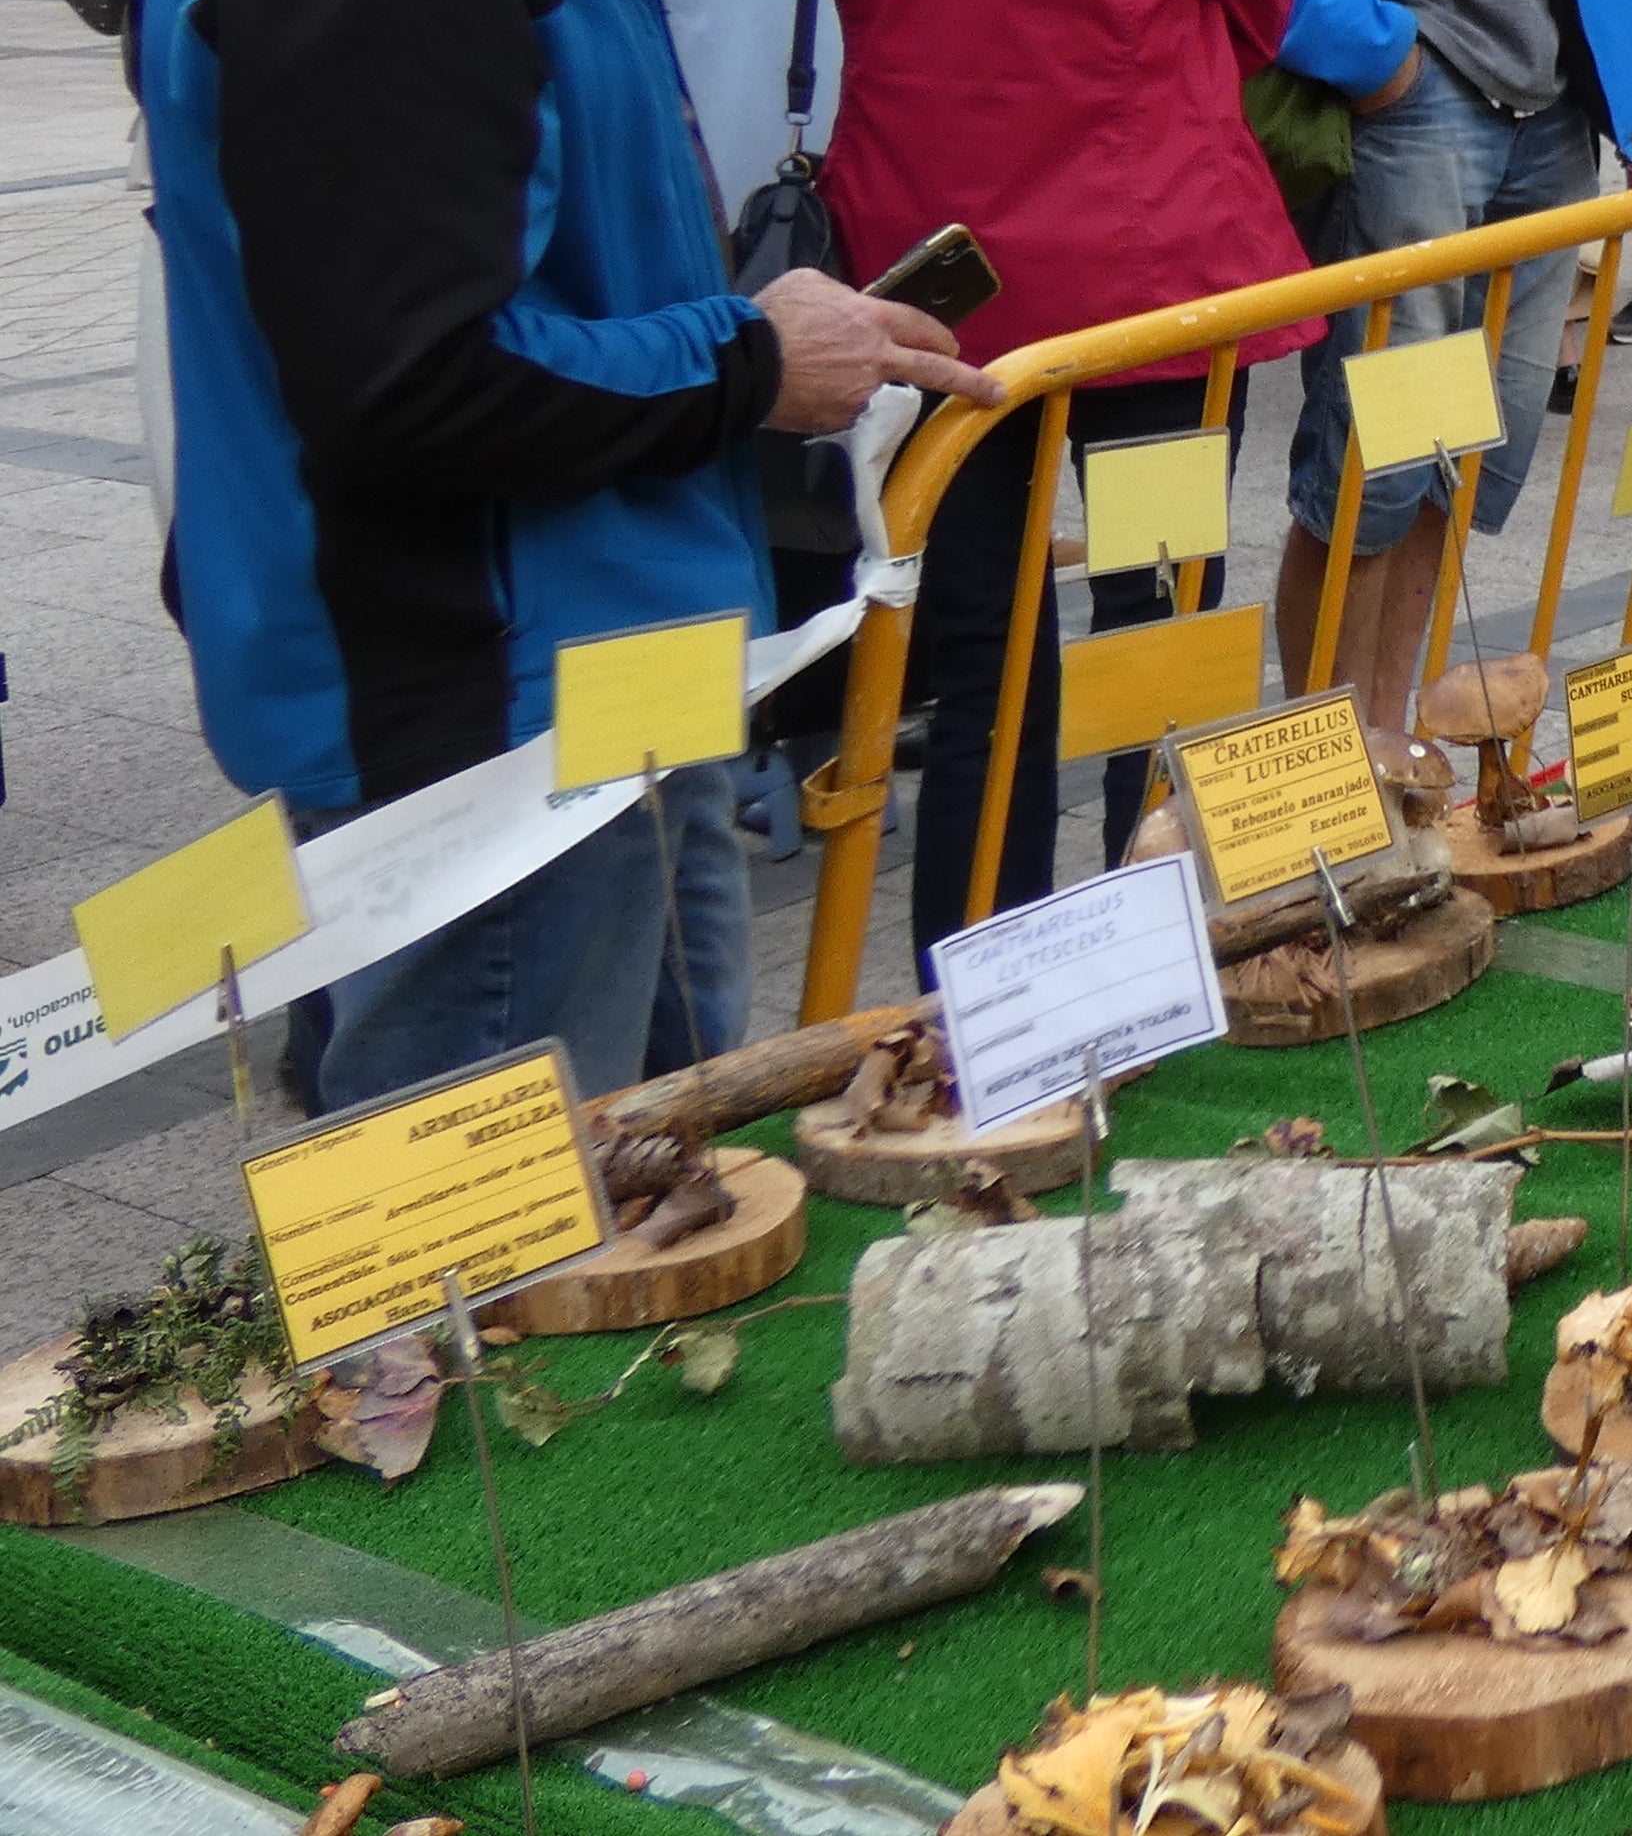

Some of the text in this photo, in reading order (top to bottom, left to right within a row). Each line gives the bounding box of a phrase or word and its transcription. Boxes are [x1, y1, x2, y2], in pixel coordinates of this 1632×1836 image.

[1214, 709, 1349, 765] CRATERELLUS
[1246, 734, 1354, 784] LUTESCENS
[1231, 775, 1371, 832] Rebozuelo anaranjado
[1309, 805, 1368, 834] Excelente
[1291, 846, 1344, 875] DEPTIVA
[406, 1076, 555, 1144] ARMILLARIA
[465, 1100, 566, 1150] MELLEA
[385, 1179, 470, 1222] Armillaria
[310, 1279, 415, 1333] ASOCIACIÓN
